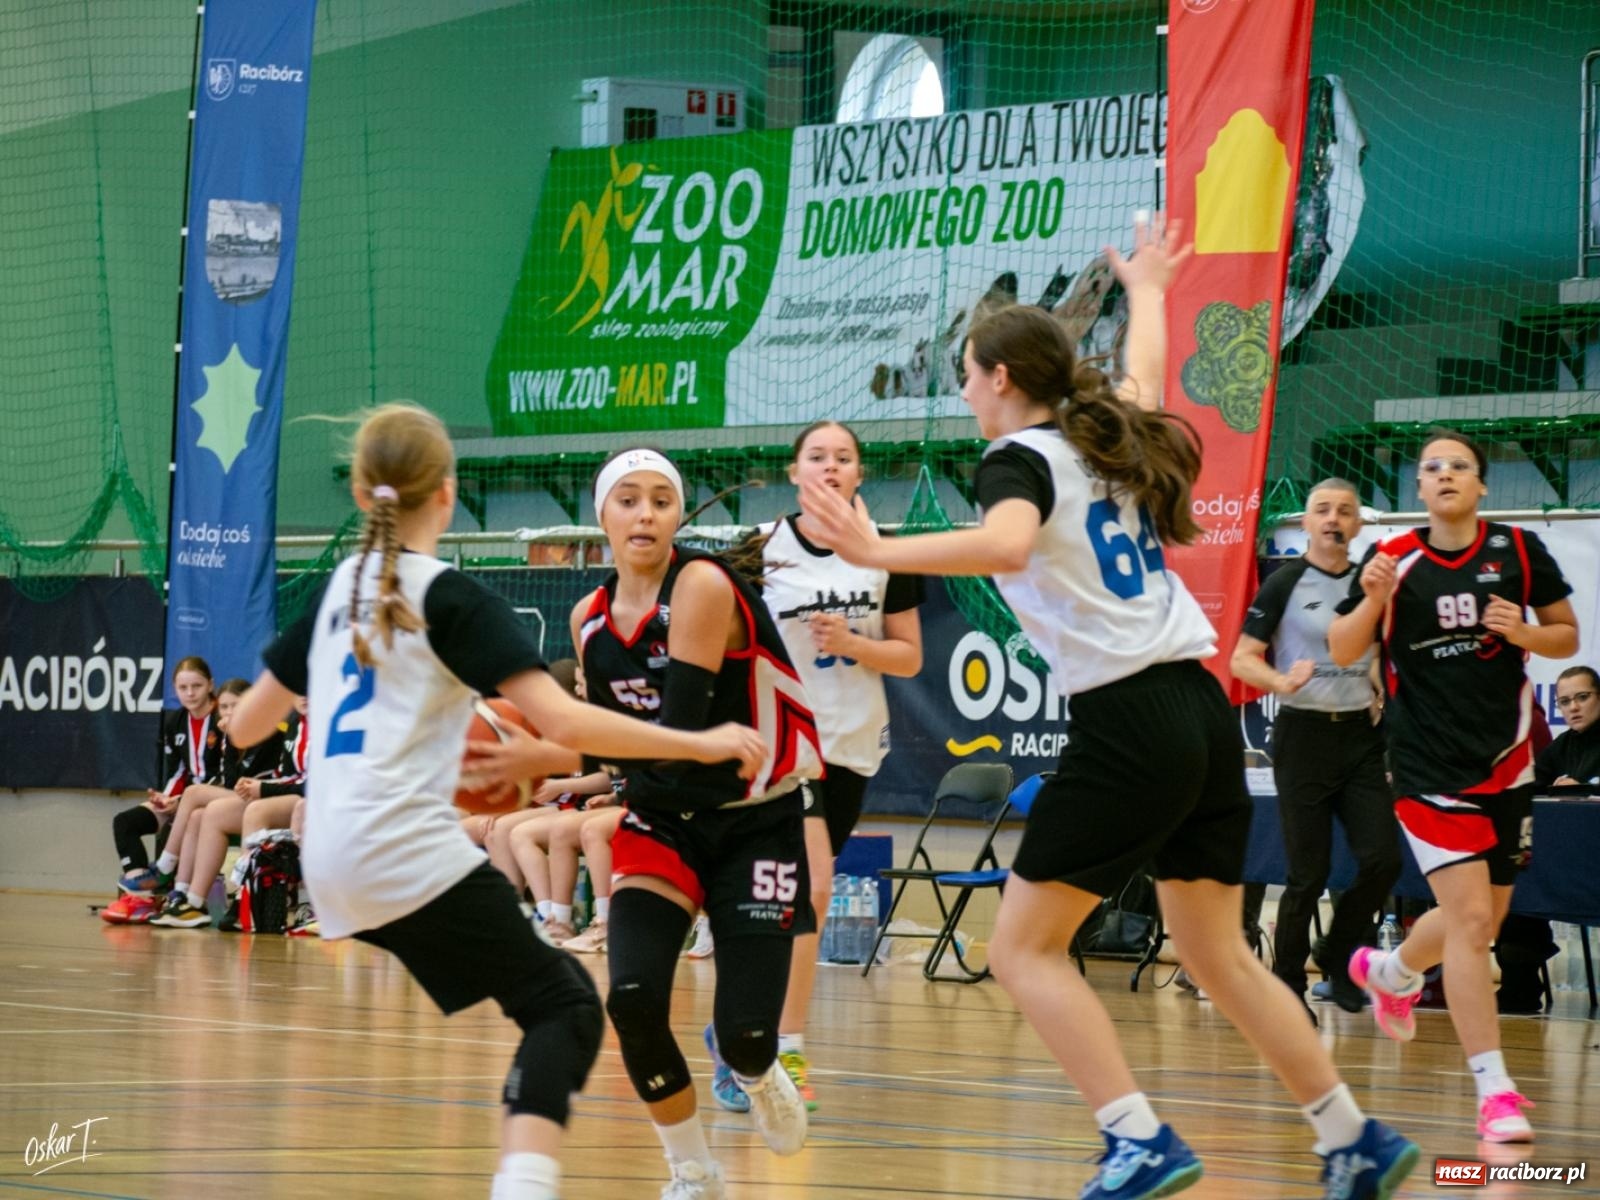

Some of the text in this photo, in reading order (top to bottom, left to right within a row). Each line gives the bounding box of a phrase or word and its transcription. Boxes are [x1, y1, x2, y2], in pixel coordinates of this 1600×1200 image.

[240, 63, 303, 82] Racibórz
[812, 114, 969, 188] WSZYSTKO
[979, 107, 1037, 171] DLA
[631, 168, 764, 244] ZOO
[798, 177, 1065, 260] DOMOWEGO ZOO
[602, 245, 747, 315] MAR
[590, 317, 729, 340] sklep zoologiczny
[509, 360, 698, 413] WWW.ZOO-MAR.PL
[1436, 593, 1478, 629] 99
[0, 635, 163, 713] ACIBÓRZ
[609, 678, 661, 710] 55
[324, 653, 376, 758] 2
[752, 860, 798, 903] 55
